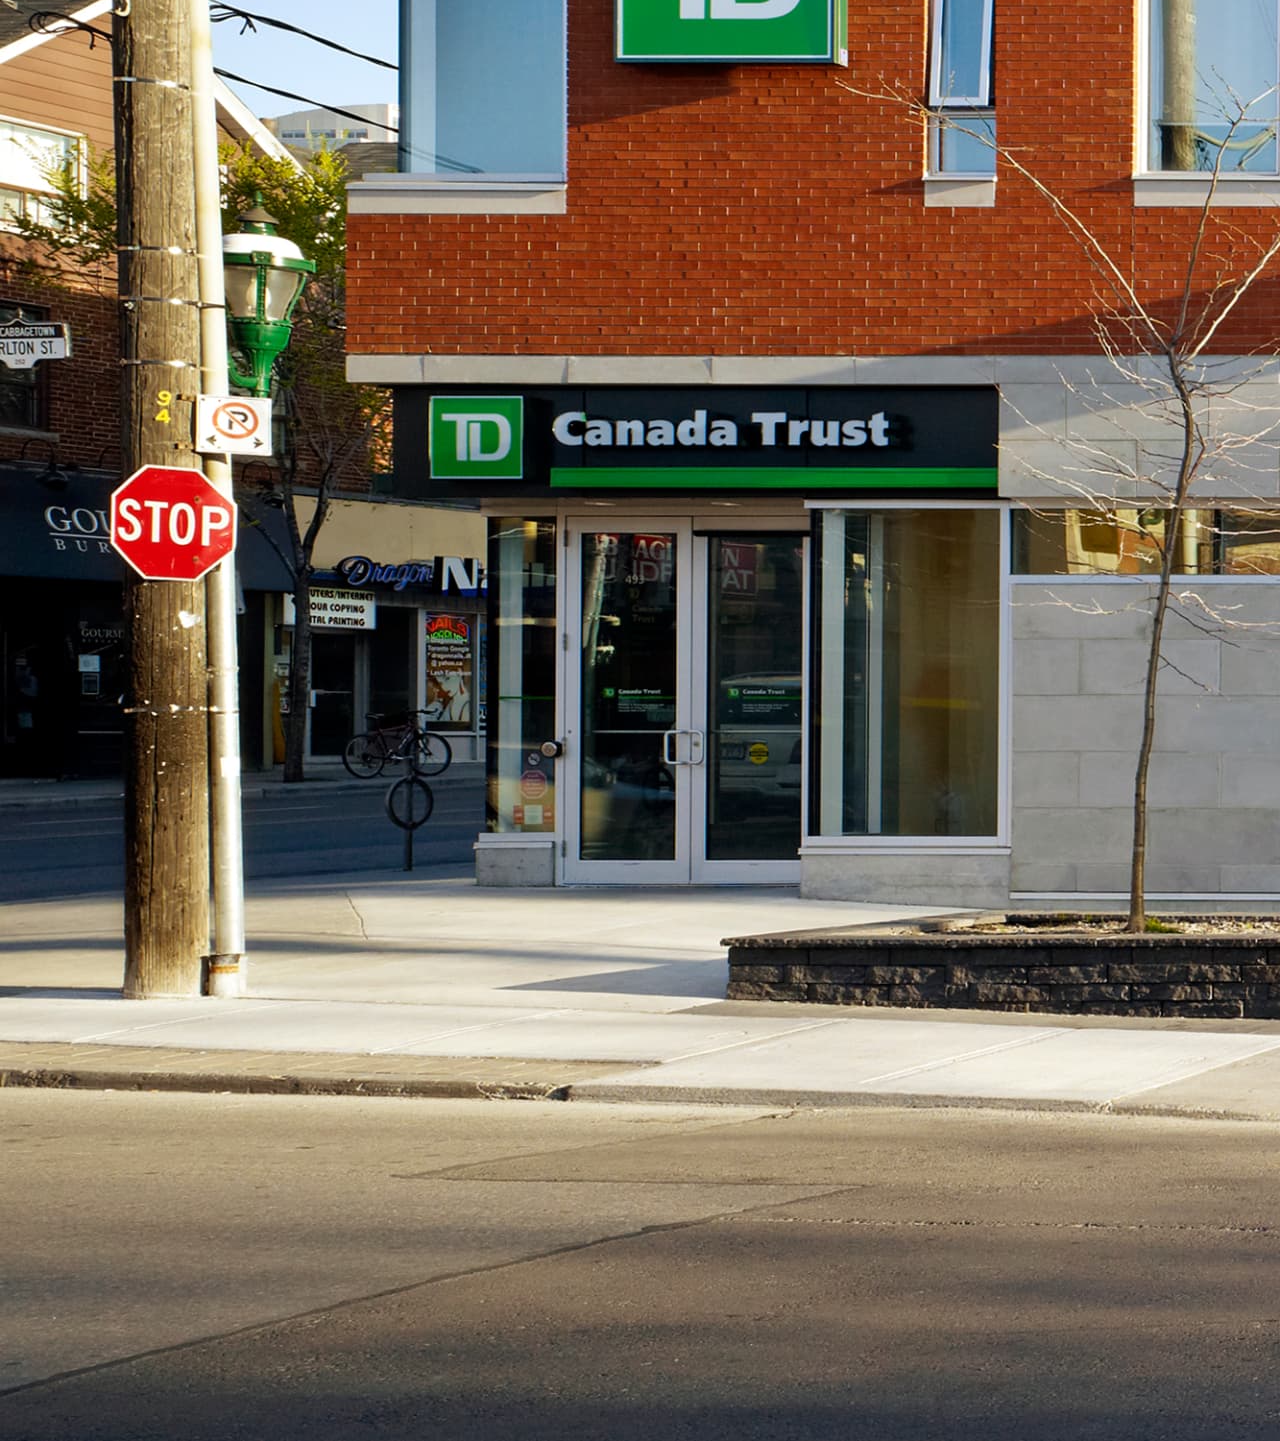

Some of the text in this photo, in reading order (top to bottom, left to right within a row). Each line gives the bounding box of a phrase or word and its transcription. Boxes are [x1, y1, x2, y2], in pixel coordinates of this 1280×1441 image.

[0, 326, 55, 337] CABBAGETOWN
[40, 340, 57, 355] ST.
[441, 411, 889, 461] TD Canada Trust
[117, 497, 231, 547] STOP
[339, 555, 434, 592] Dragon
[625, 575, 645, 585] 493
[329, 603, 366, 614] COPYING
[328, 616, 366, 627] PRINTING
